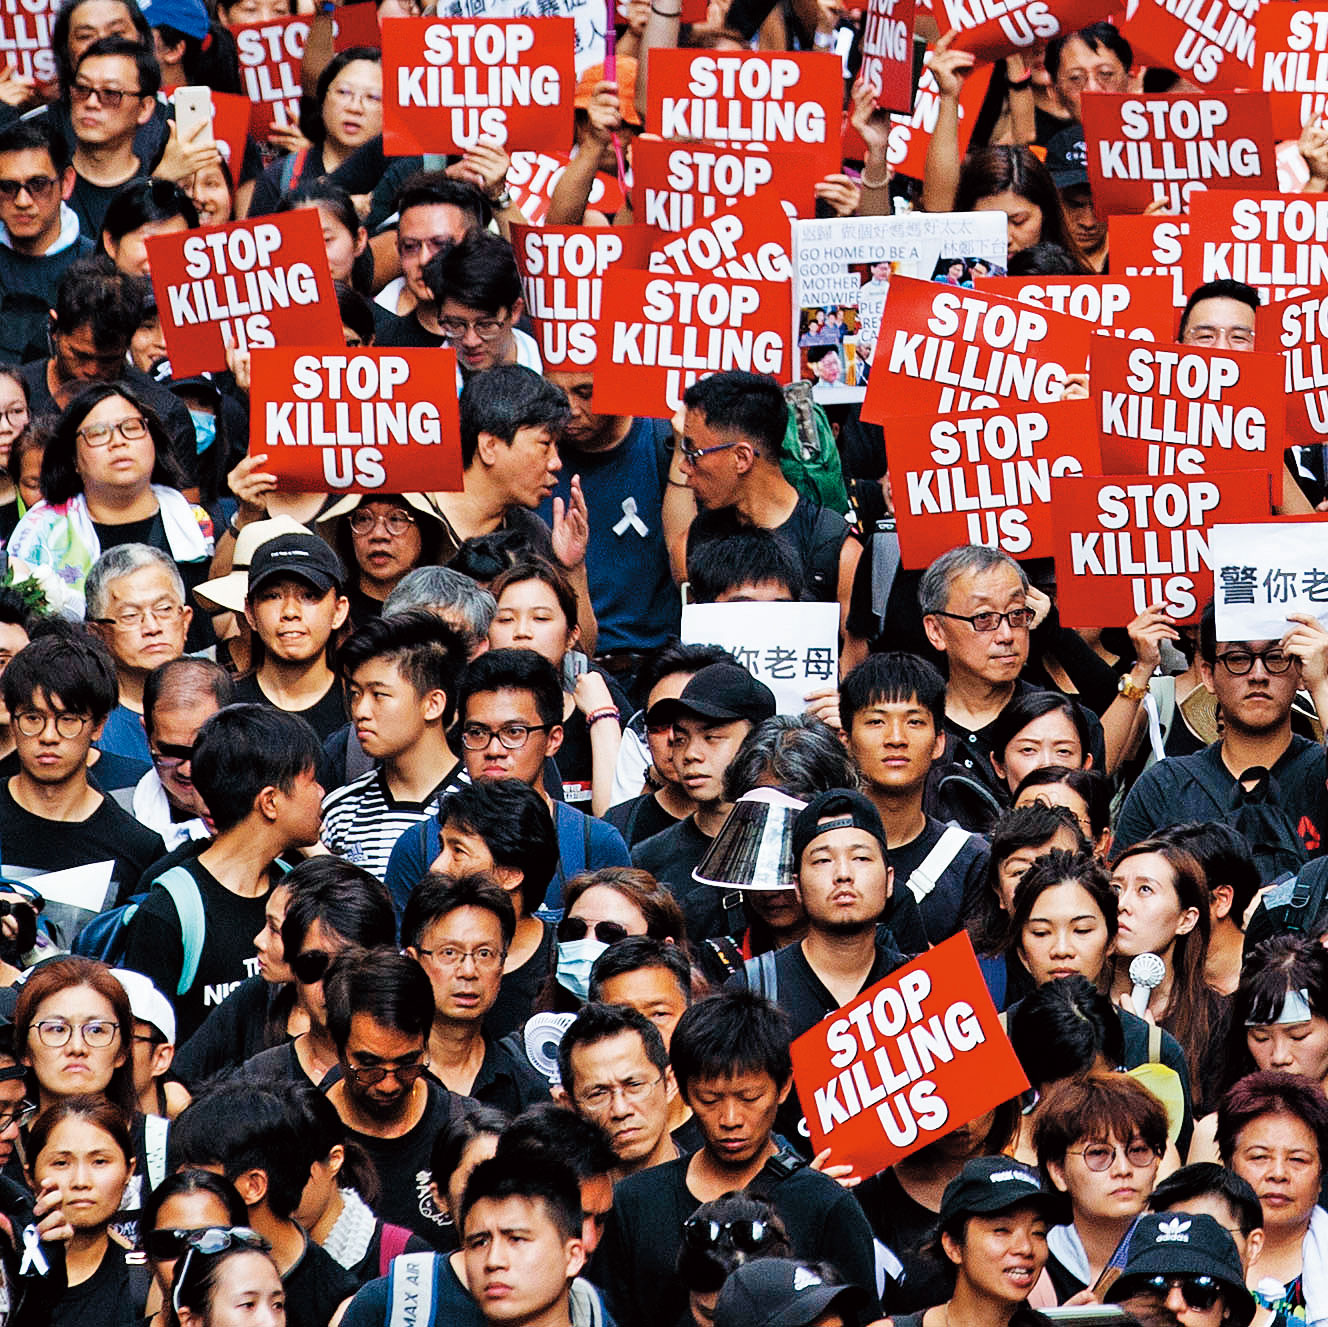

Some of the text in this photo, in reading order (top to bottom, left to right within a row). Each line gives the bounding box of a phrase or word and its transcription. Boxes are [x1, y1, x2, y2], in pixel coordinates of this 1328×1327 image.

[423, 24, 533, 65] STOP
[1000, 2, 1061, 47] US
[398, 65, 560, 107] KILLING
[452, 107, 509, 148] US
[1121, 101, 1228, 138] STOP
[1100, 139, 1260, 179] KILLING
[1151, 180, 1205, 217] US
[183, 223, 281, 279] STOP
[800, 247, 919, 261] GO HOME TO BE A
[800, 262, 841, 276] GOOD
[168, 264, 318, 325] KILLING
[802, 277, 858, 290] MOTHER
[219, 315, 276, 352] US
[292, 356, 410, 400] STOP
[266, 402, 440, 446] KILLING
[322, 447, 387, 488] US
[722, 646, 837, 679] 你老母
[825, 969, 932, 1066] STOP
[814, 1000, 986, 1125] KILLING
[879, 1083, 949, 1147] US
